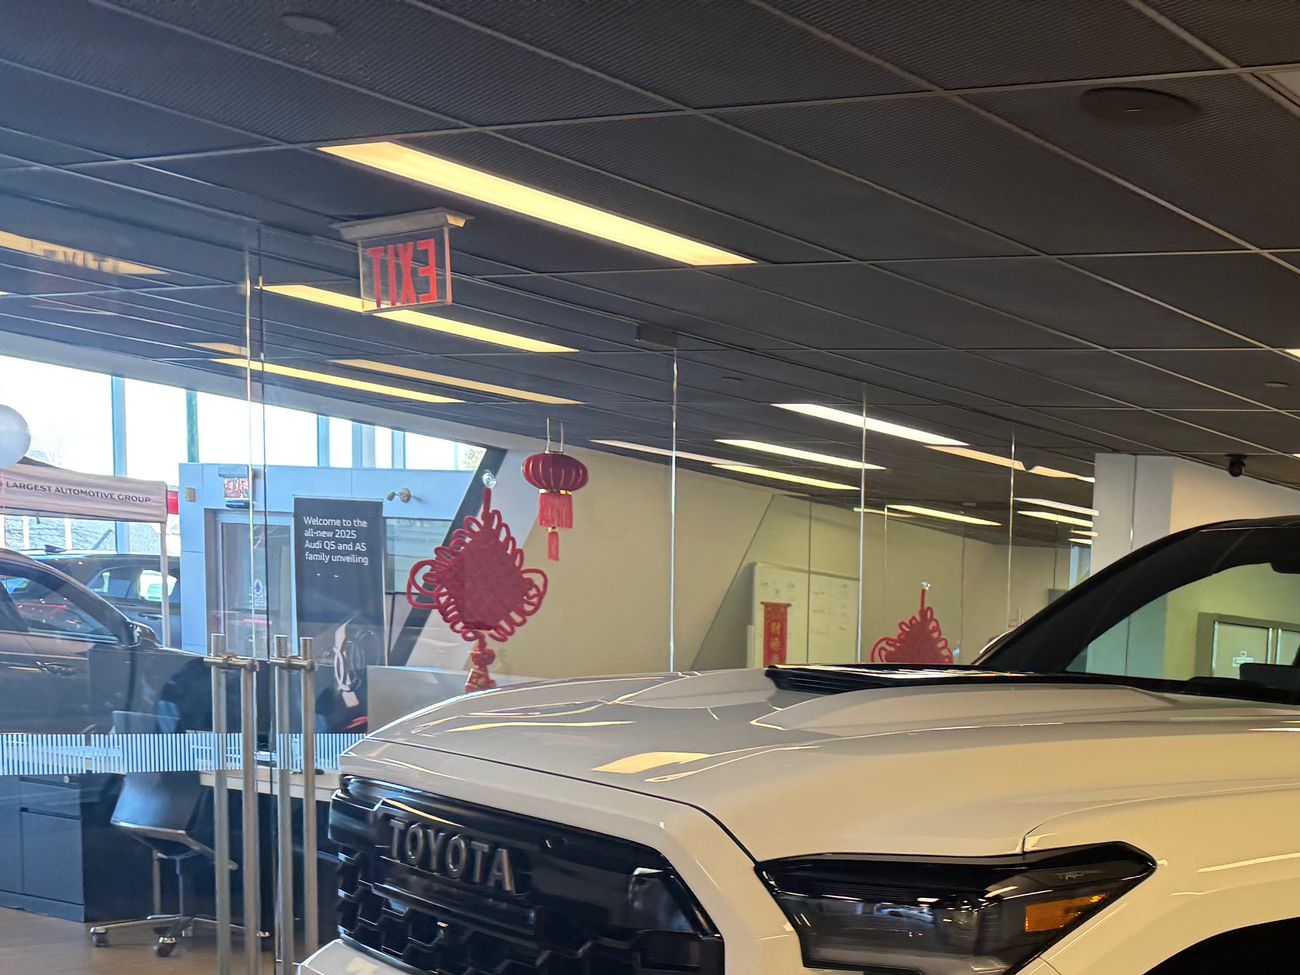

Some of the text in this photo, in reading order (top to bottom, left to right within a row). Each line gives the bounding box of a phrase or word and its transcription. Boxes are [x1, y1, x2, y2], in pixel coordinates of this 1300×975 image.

[6, 481, 51, 492] LARGEST
[55, 486, 116, 500] AUTOMOTIVE
[117, 493, 152, 503] GROUP
[303, 516, 368, 528] Welcome to the
[304, 528, 357, 539] all-new 2025
[304, 540, 367, 552] Audi Q5 and A5
[305, 551, 369, 566] family unveiling
[389, 818, 515, 894] TOYOTA
